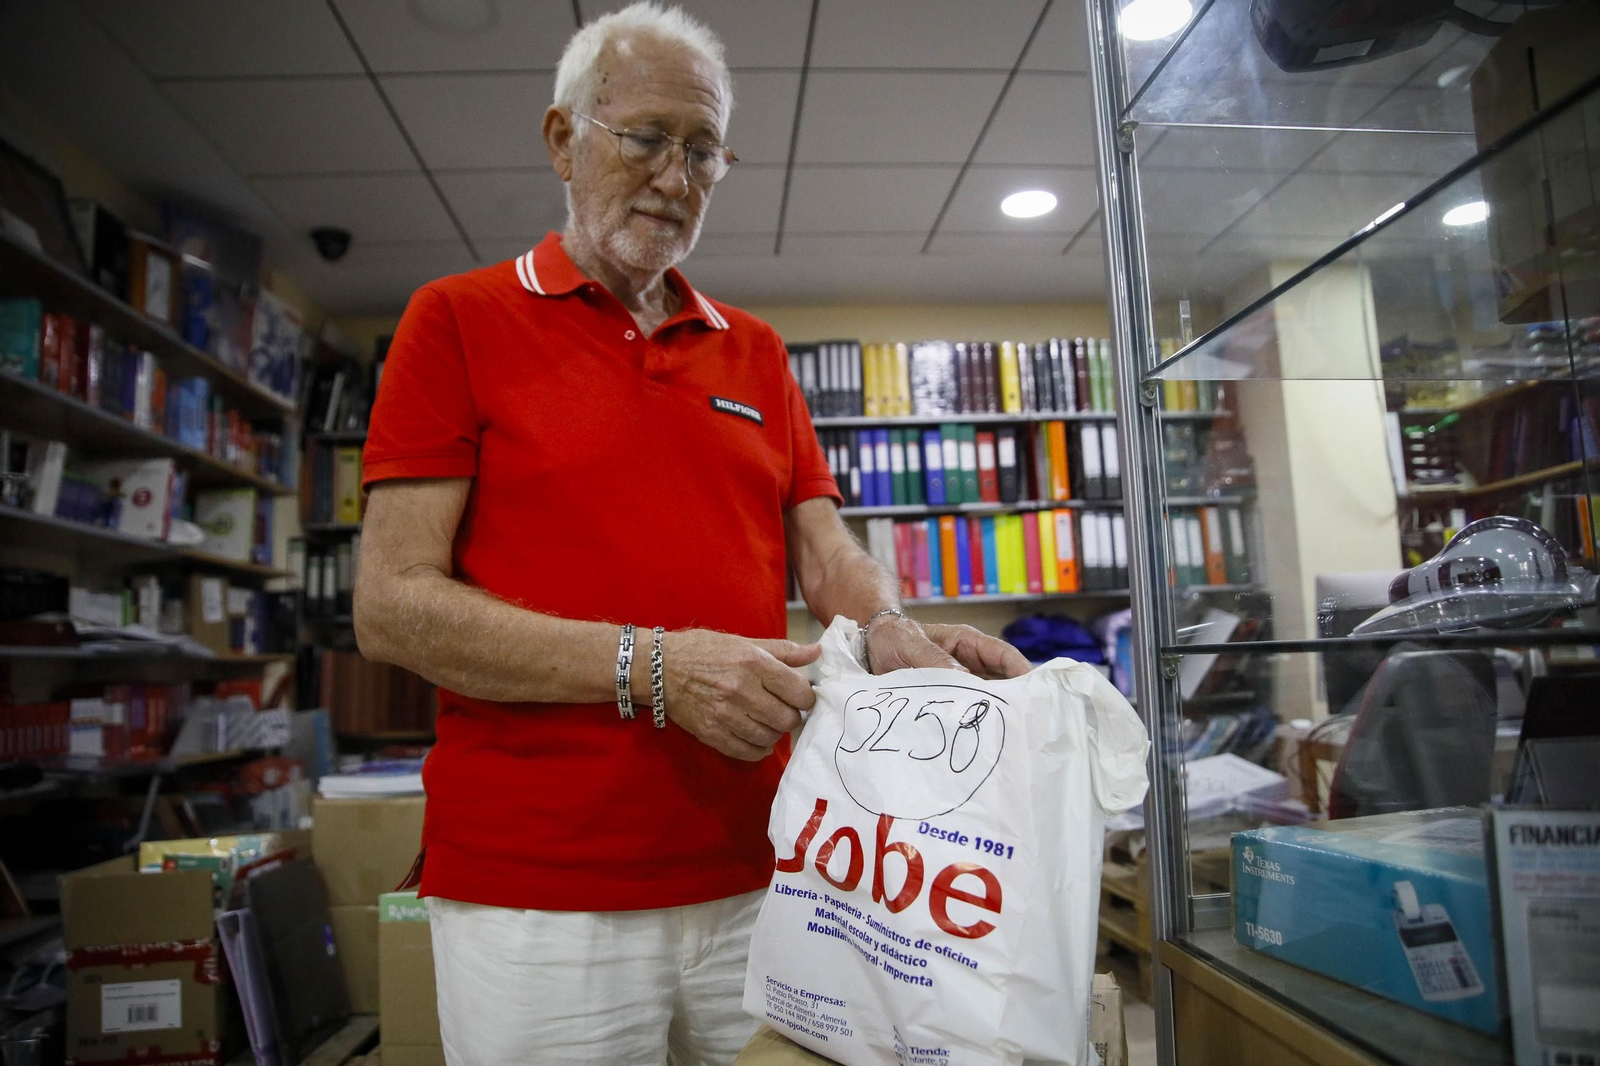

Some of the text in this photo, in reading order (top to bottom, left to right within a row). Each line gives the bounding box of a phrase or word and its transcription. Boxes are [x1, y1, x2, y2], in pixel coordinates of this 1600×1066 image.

[715, 398, 762, 421] HILFIGER
[918, 821, 1014, 860] Desde 1981
[776, 798, 1003, 939] Jobe
[1242, 862, 1295, 885] INSTRUMENTS
[814, 907, 928, 968] Material escolar y didáctico
[865, 914, 911, 947] Suministros
[914, 938, 932, 951] de
[934, 945, 979, 970] oficina
[1245, 921, 1283, 946] TI-5630
[883, 962, 933, 987] Imprenta
[766, 975, 792, 992] Servicio
[800, 989, 846, 1008] Empresas:
[773, 986, 787, 998] Pablo
[810, 1001, 819, 1010] 31
[786, 1001, 793, 1010] de
[765, 1011, 828, 1042] www.lpjobe.com
[773, 1004, 784, 1014] 950
[785, 1009, 795, 1018] 144
[796, 1012, 807, 1023] 809
[811, 1020, 824, 1030] 658
[825, 1023, 839, 1033] 997
[839, 1028, 853, 1038] 501
[909, 1046, 950, 1057] Tienda:
[909, 1056, 938, 1066] nfante,
